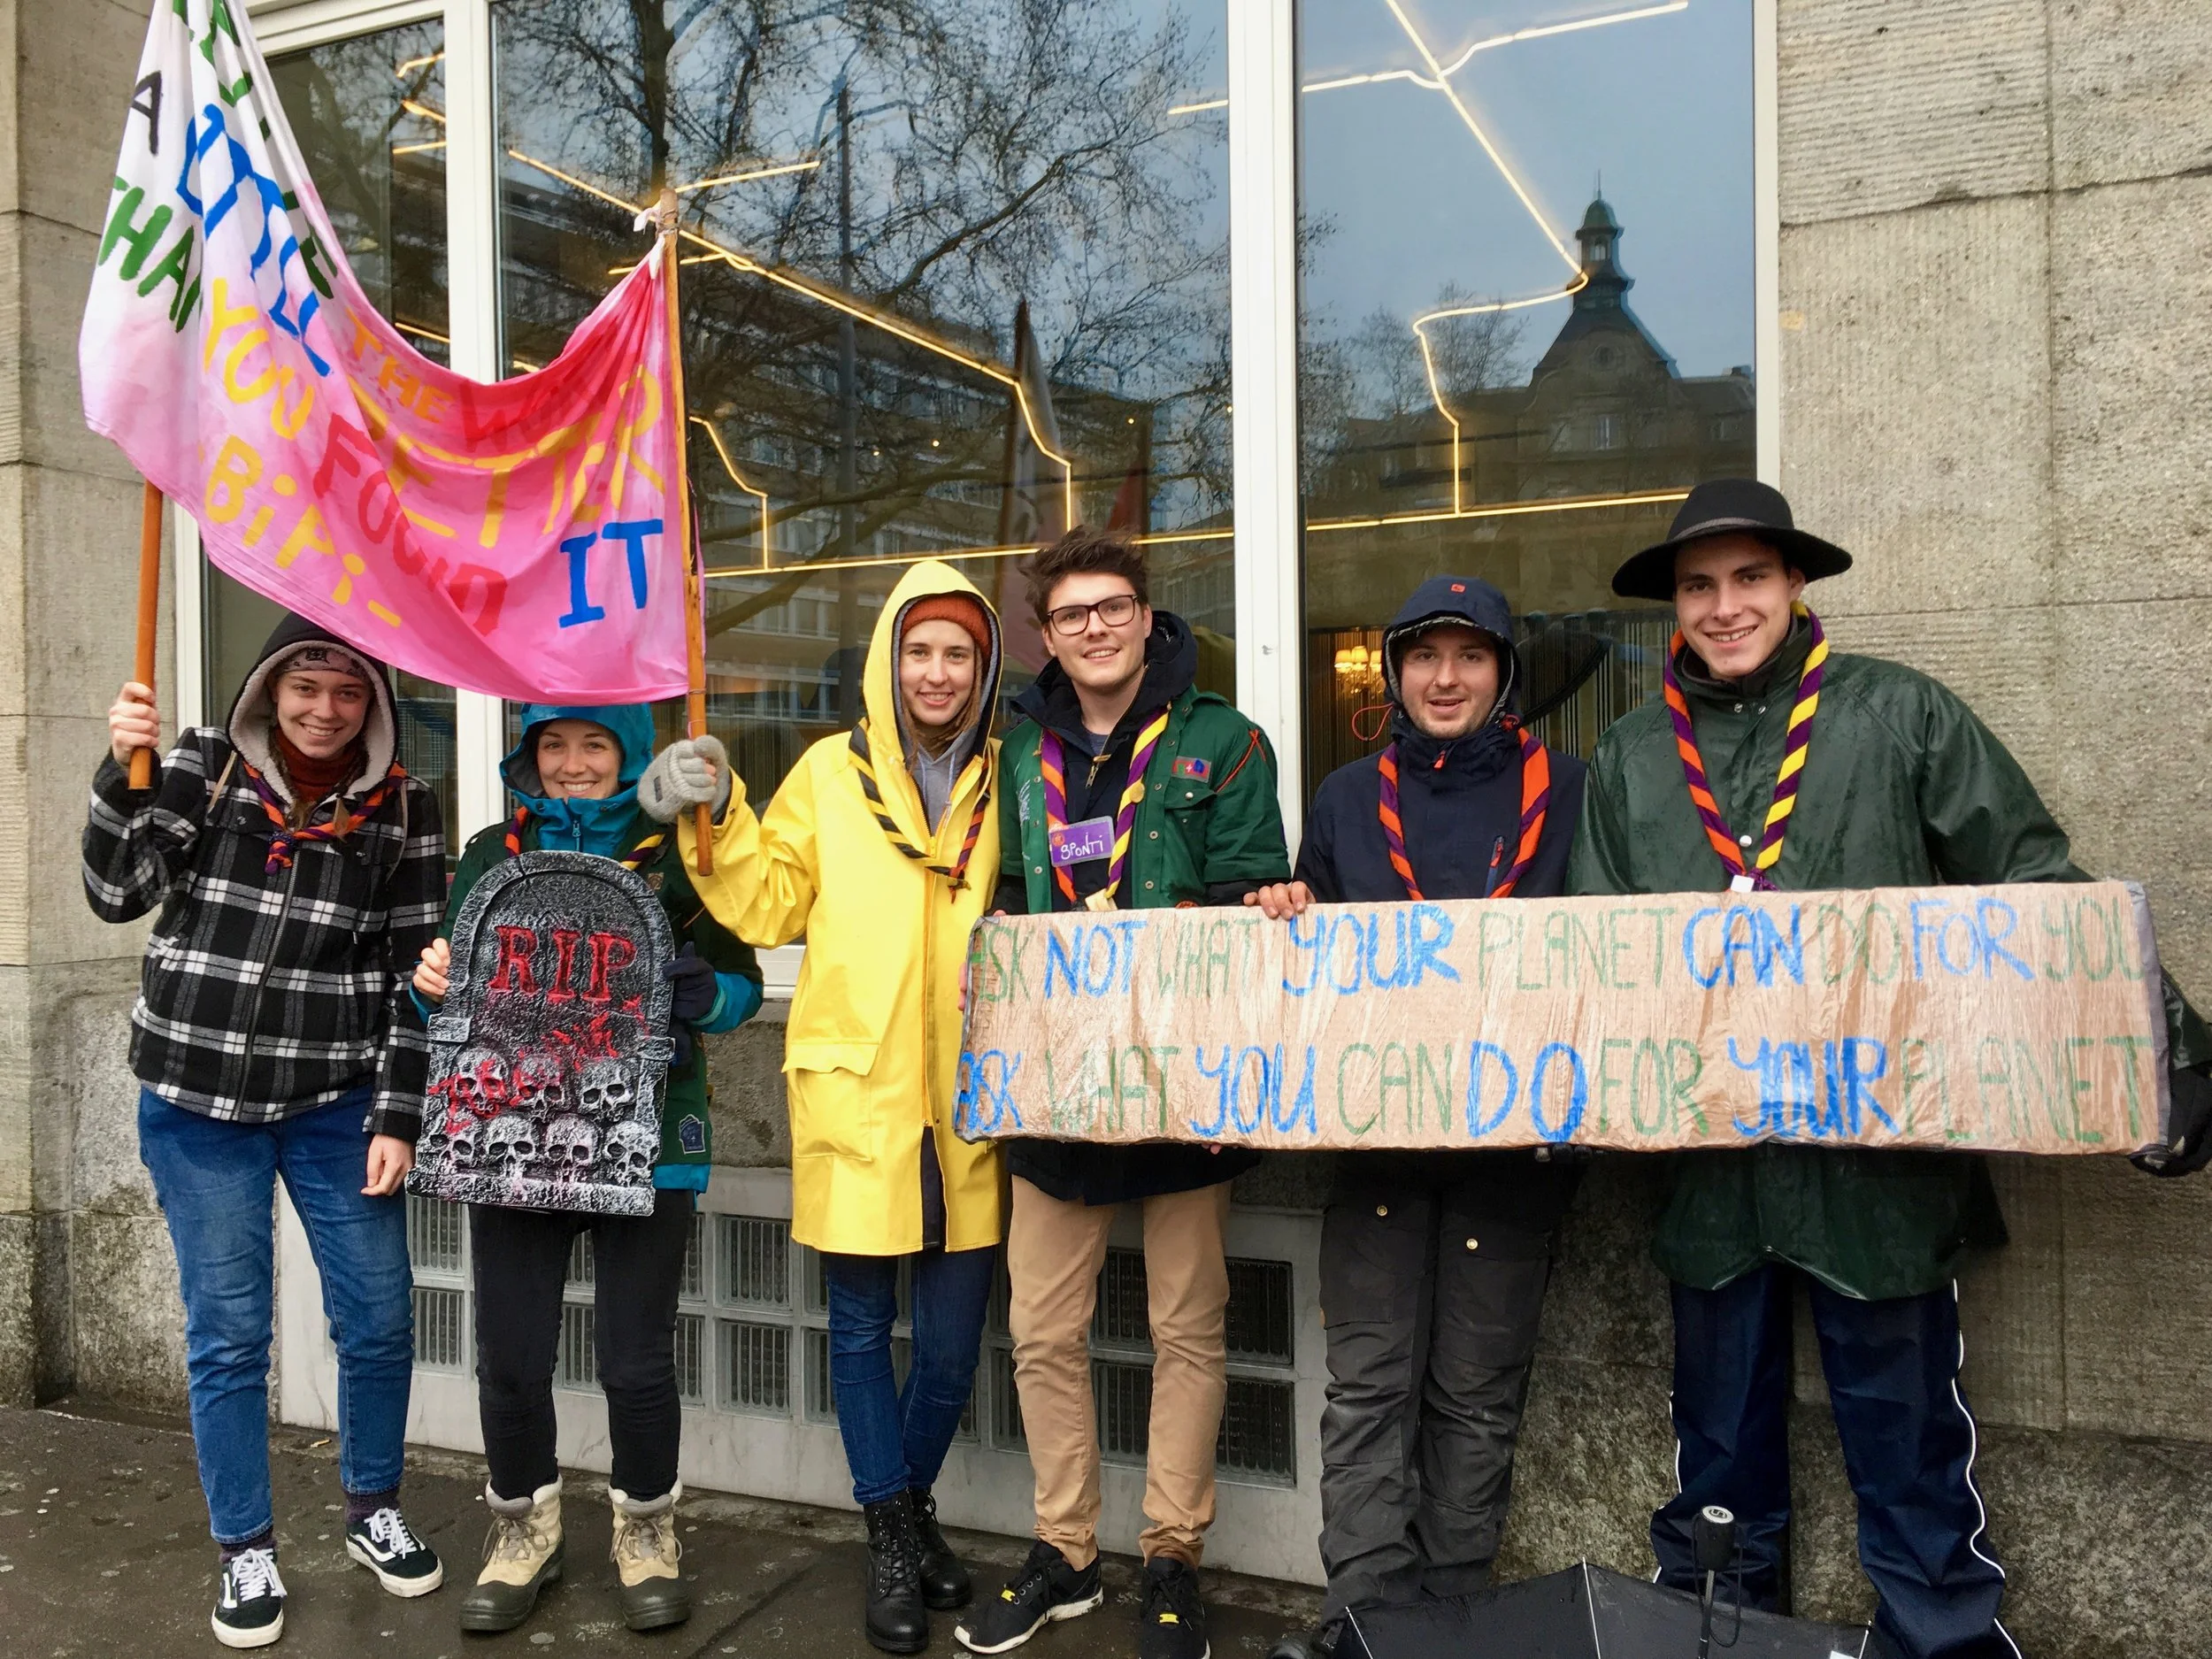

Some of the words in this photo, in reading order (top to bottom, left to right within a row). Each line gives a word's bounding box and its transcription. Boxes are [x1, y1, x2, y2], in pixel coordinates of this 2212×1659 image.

[131, 71, 163, 155] A
[98, 175, 204, 334] HA
[204, 278, 315, 441] YOU
[558, 518, 664, 628] IT
[347, 307, 456, 425] THE
[488, 925, 637, 1003] RIP
[1045, 920, 1148, 1001] NOT
[1154, 918, 1263, 1000] WHAT
[1281, 904, 1463, 997] YOUR
[1478, 908, 1678, 990] PLANET
[1682, 903, 1804, 989] CAN
[1817, 902, 1901, 986] DO
[1909, 897, 2034, 982] FOR
[1045, 1045, 1182, 1134] WHAT
[1189, 1042, 1318, 1137] YOU
[1337, 1041, 1453, 1136] CAN
[1466, 1040, 1588, 1141] DO
[1599, 1037, 1709, 1136] FOR
[1727, 1035, 1901, 1139] YOUR
[1901, 1036, 2154, 1144] PLANET
